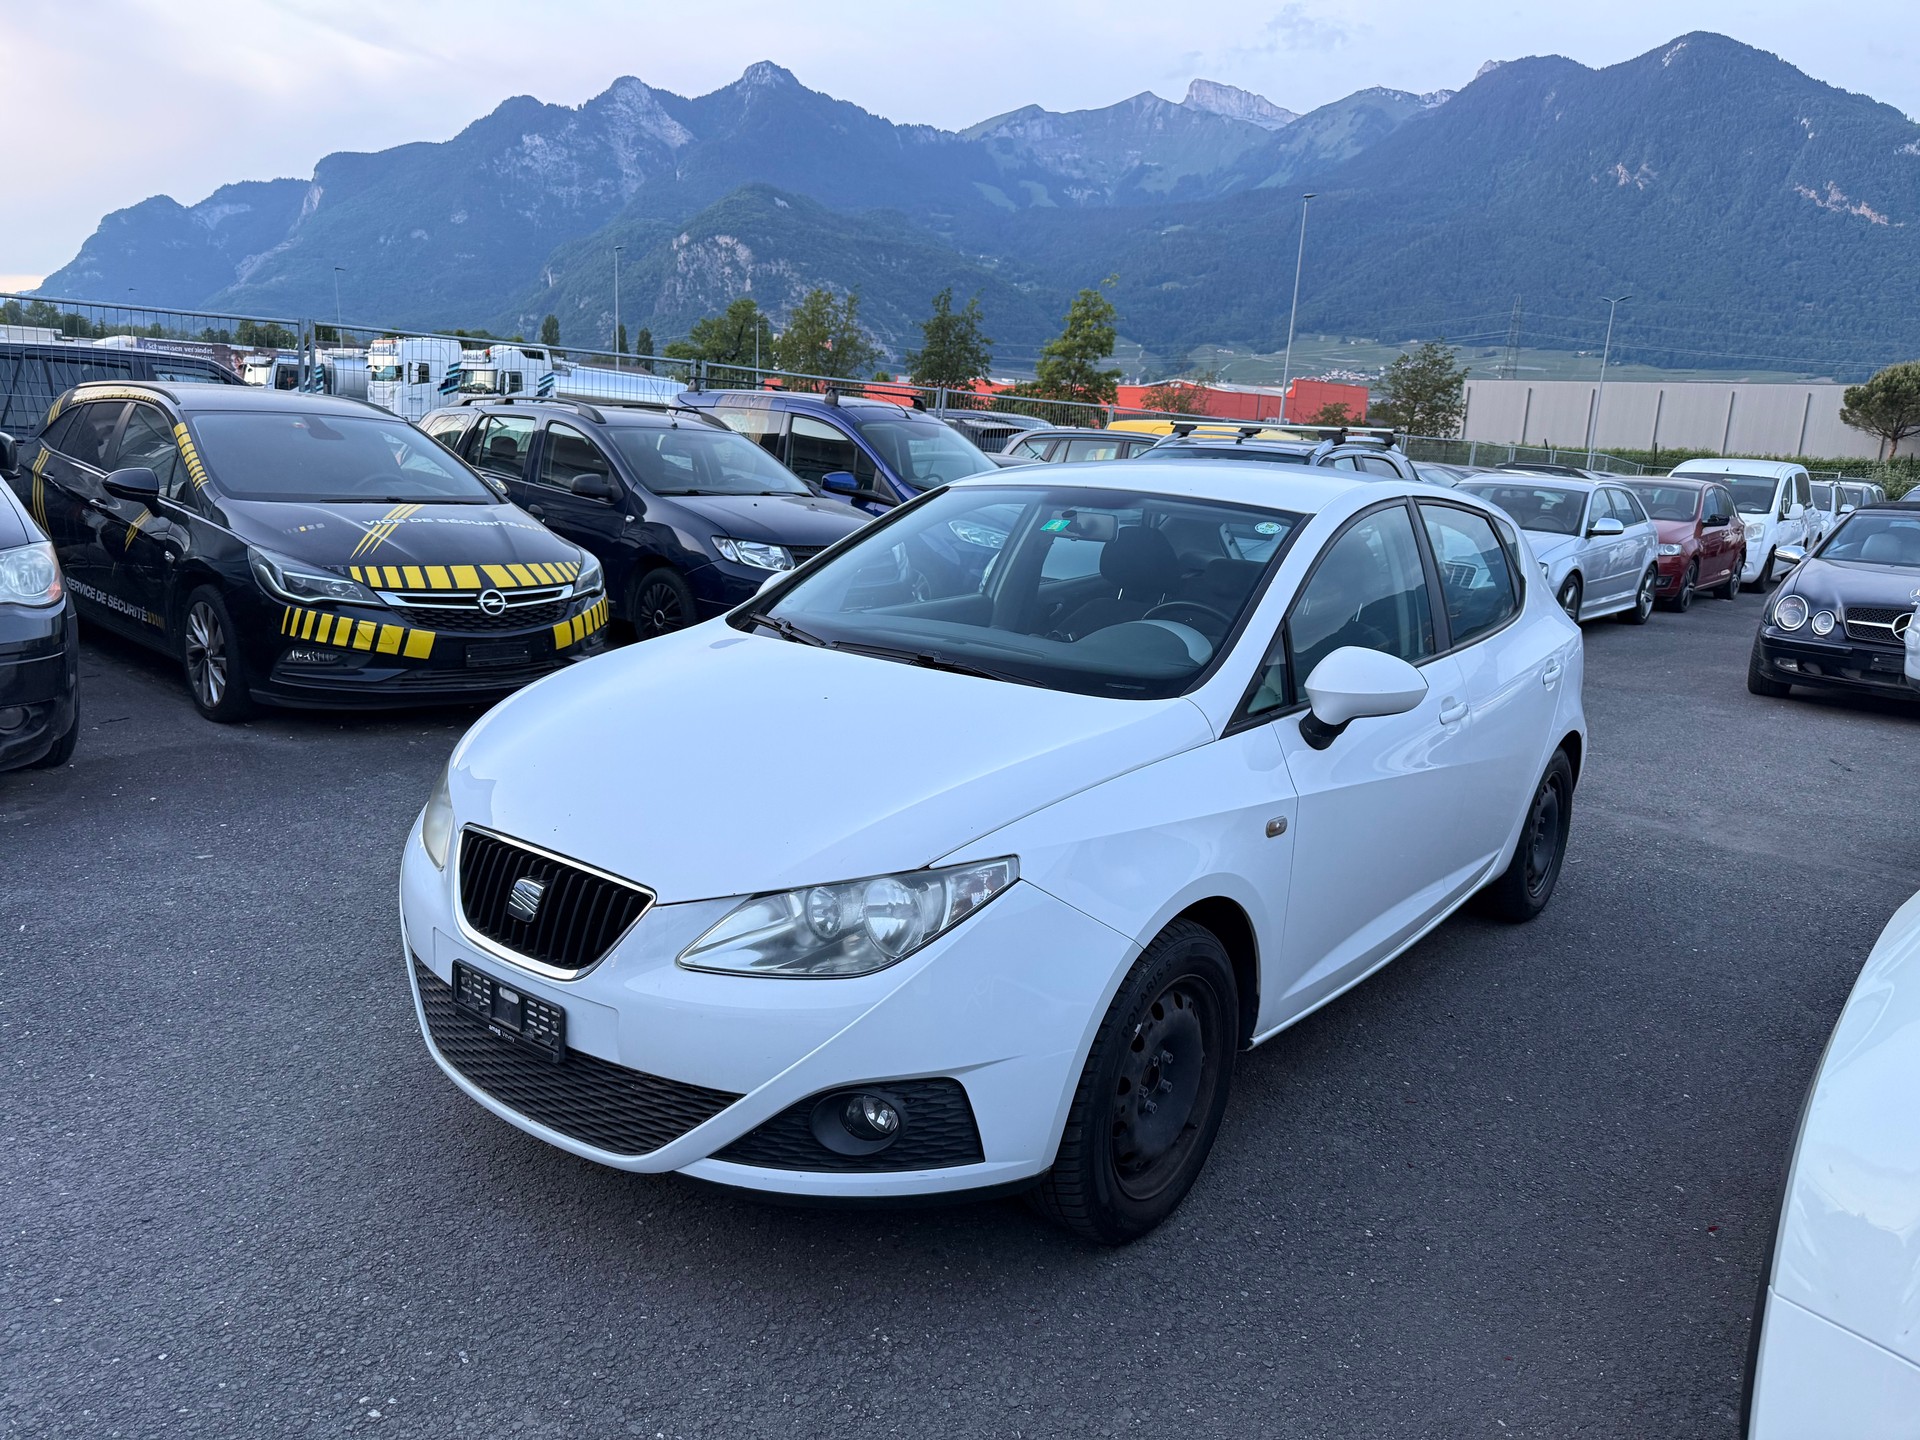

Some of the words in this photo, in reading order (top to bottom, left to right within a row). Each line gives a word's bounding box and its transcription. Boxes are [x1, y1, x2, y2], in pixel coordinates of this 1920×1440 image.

[66, 577, 96, 600] SERVICE
[96, 590, 107, 605] DE
[107, 594, 148, 622] SÉCURITÉ
[1121, 968, 1163, 1038] POLARIS
